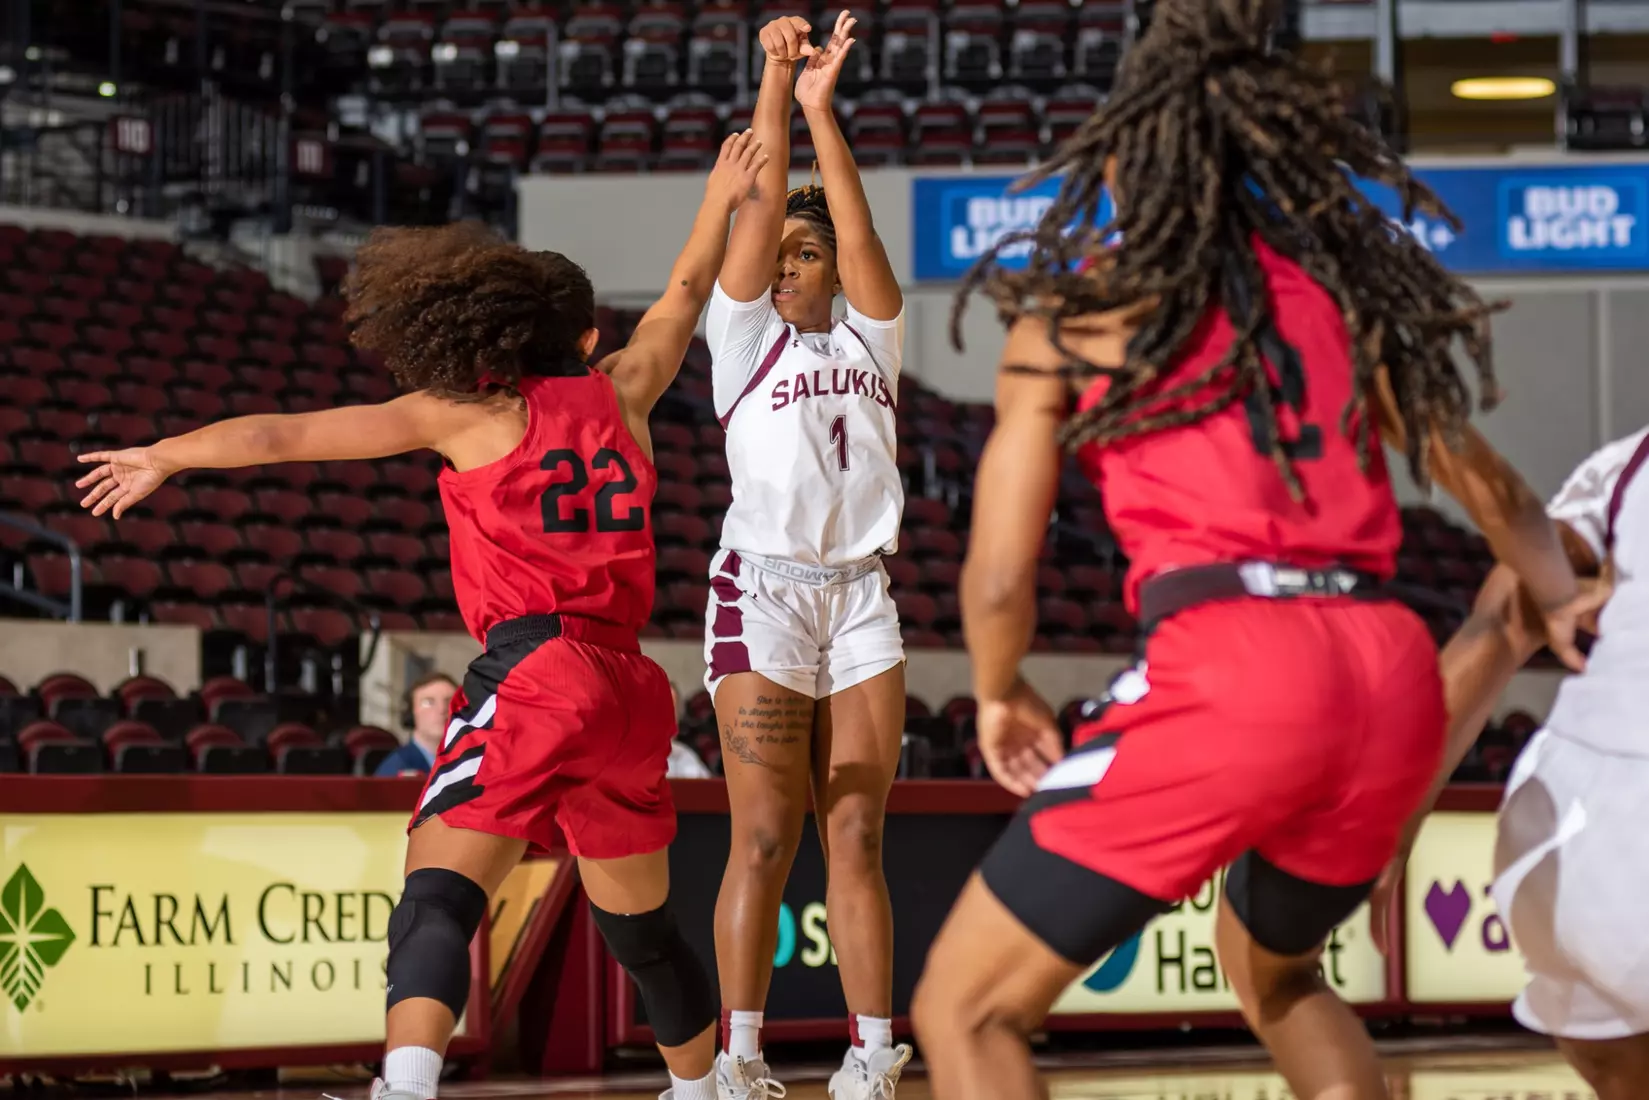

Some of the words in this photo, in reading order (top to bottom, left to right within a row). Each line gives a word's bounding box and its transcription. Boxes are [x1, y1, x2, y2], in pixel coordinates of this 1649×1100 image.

[1524, 186, 1619, 219] BUD
[1507, 214, 1636, 249] LIGHT
[771, 368, 889, 412] SALUKIS
[829, 415, 850, 472] 1
[540, 447, 645, 533] 22
[88, 885, 237, 947] FARM
[257, 883, 403, 944] CRED
